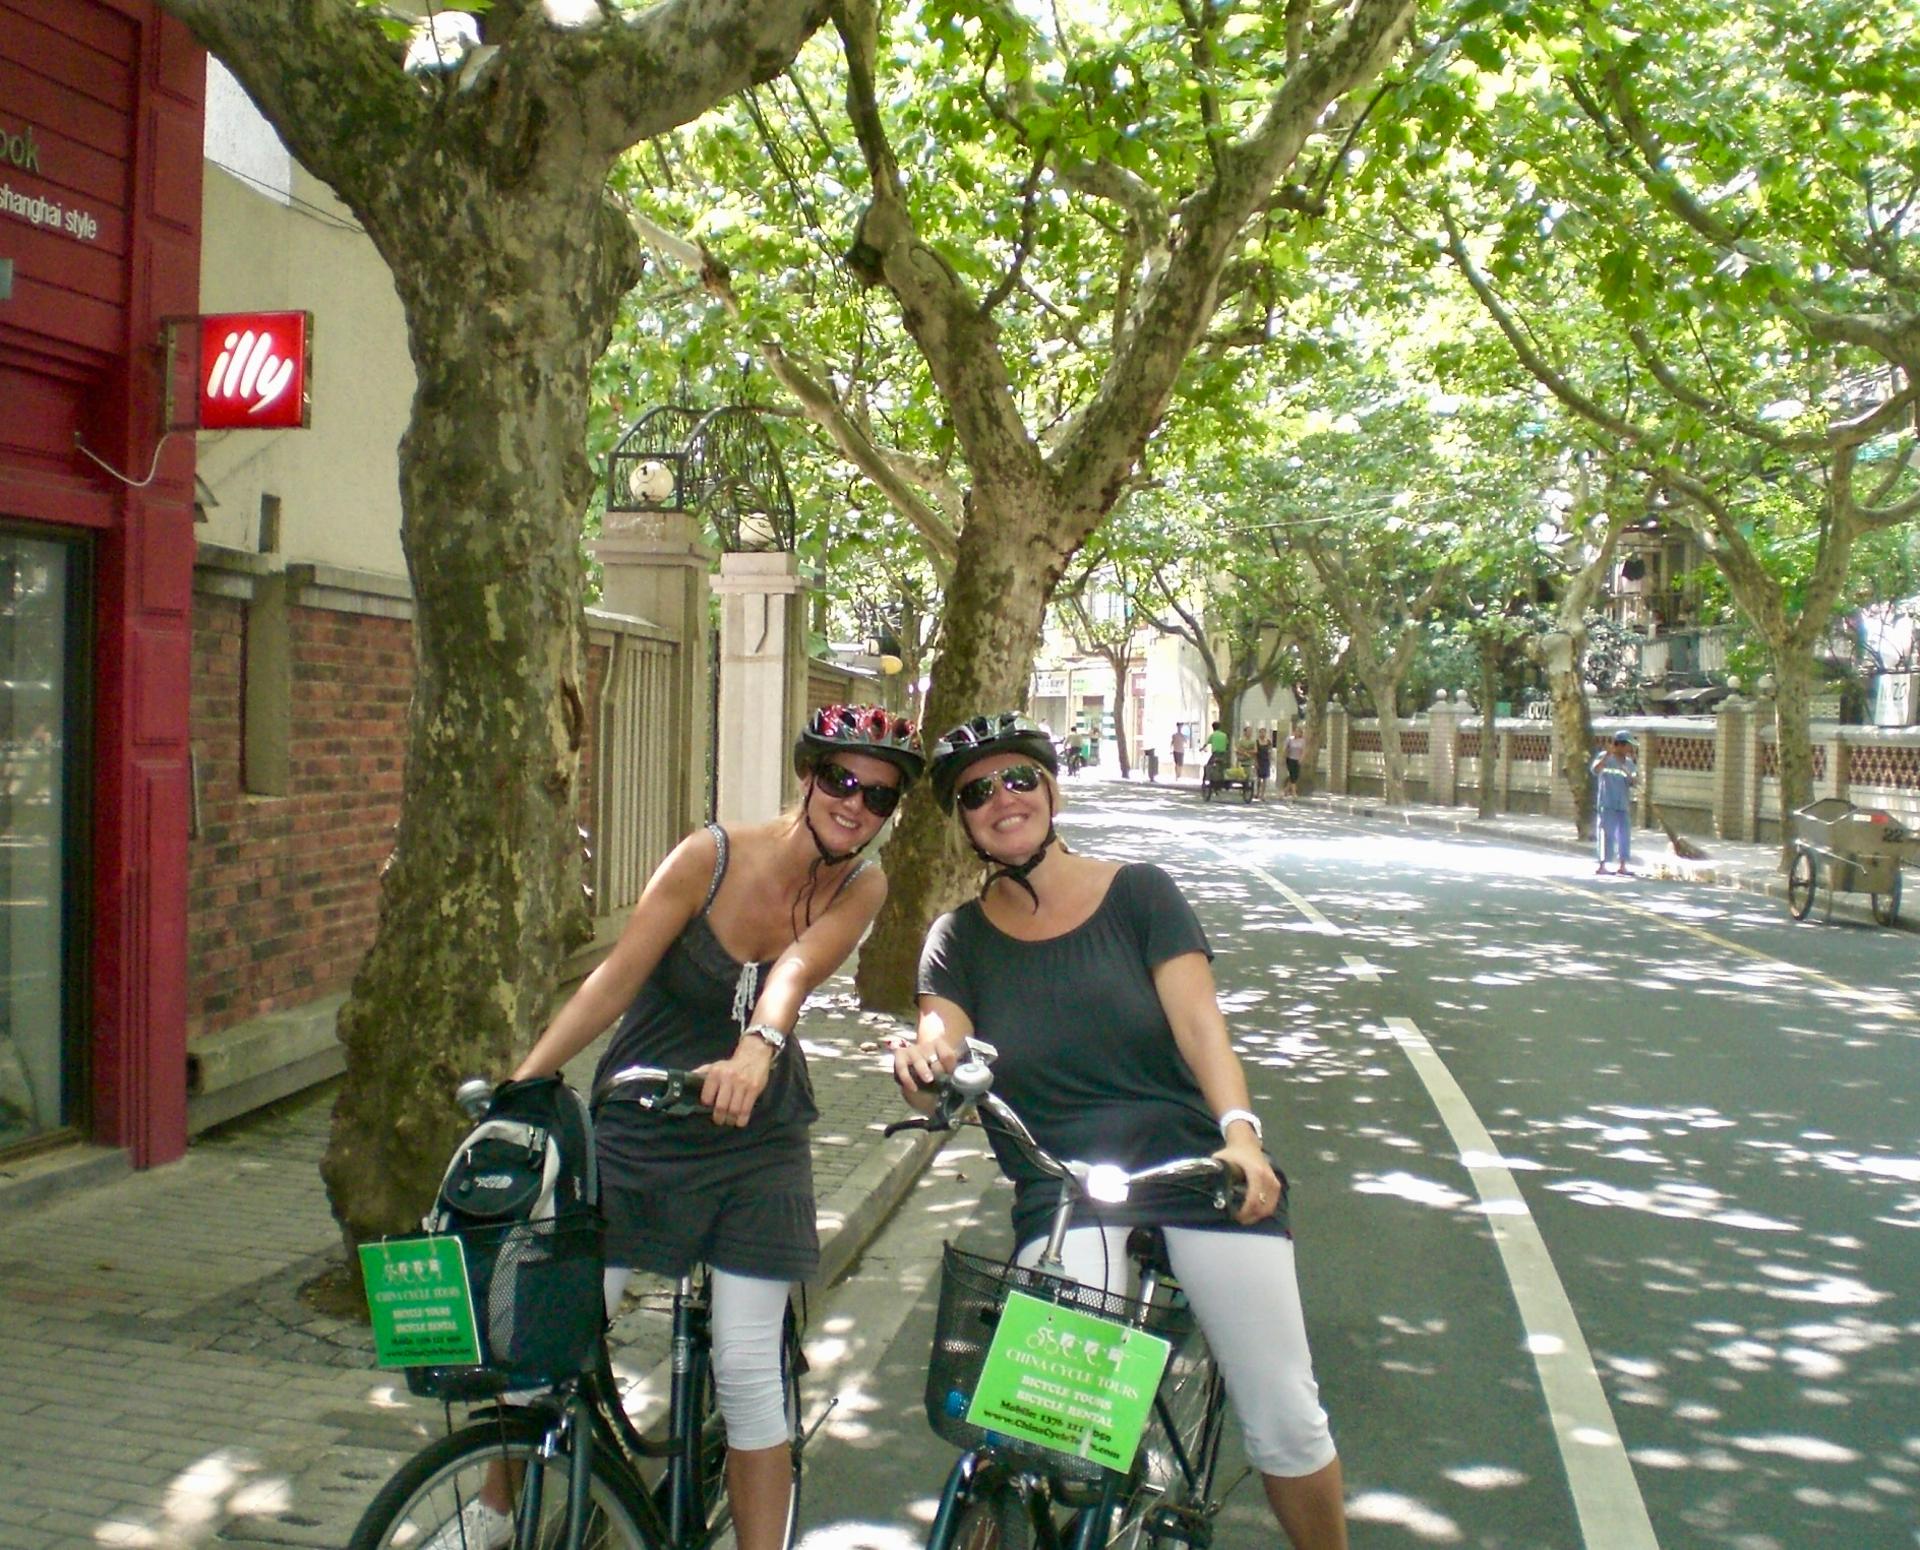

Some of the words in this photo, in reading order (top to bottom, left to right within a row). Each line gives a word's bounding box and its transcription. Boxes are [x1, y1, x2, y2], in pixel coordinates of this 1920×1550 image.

[65, 209, 97, 240] style
[207, 330, 294, 414] illy
[1005, 1348, 1048, 1372] CHINA
[1050, 1361, 1093, 1384] CYCLE
[1097, 1374, 1139, 1400] TOURS
[1021, 1374, 1071, 1397] BICYCLE
[1073, 1390, 1113, 1411] TOURS
[1016, 1389, 1065, 1413] BICYCLE
[1067, 1404, 1113, 1428] RENTAL
